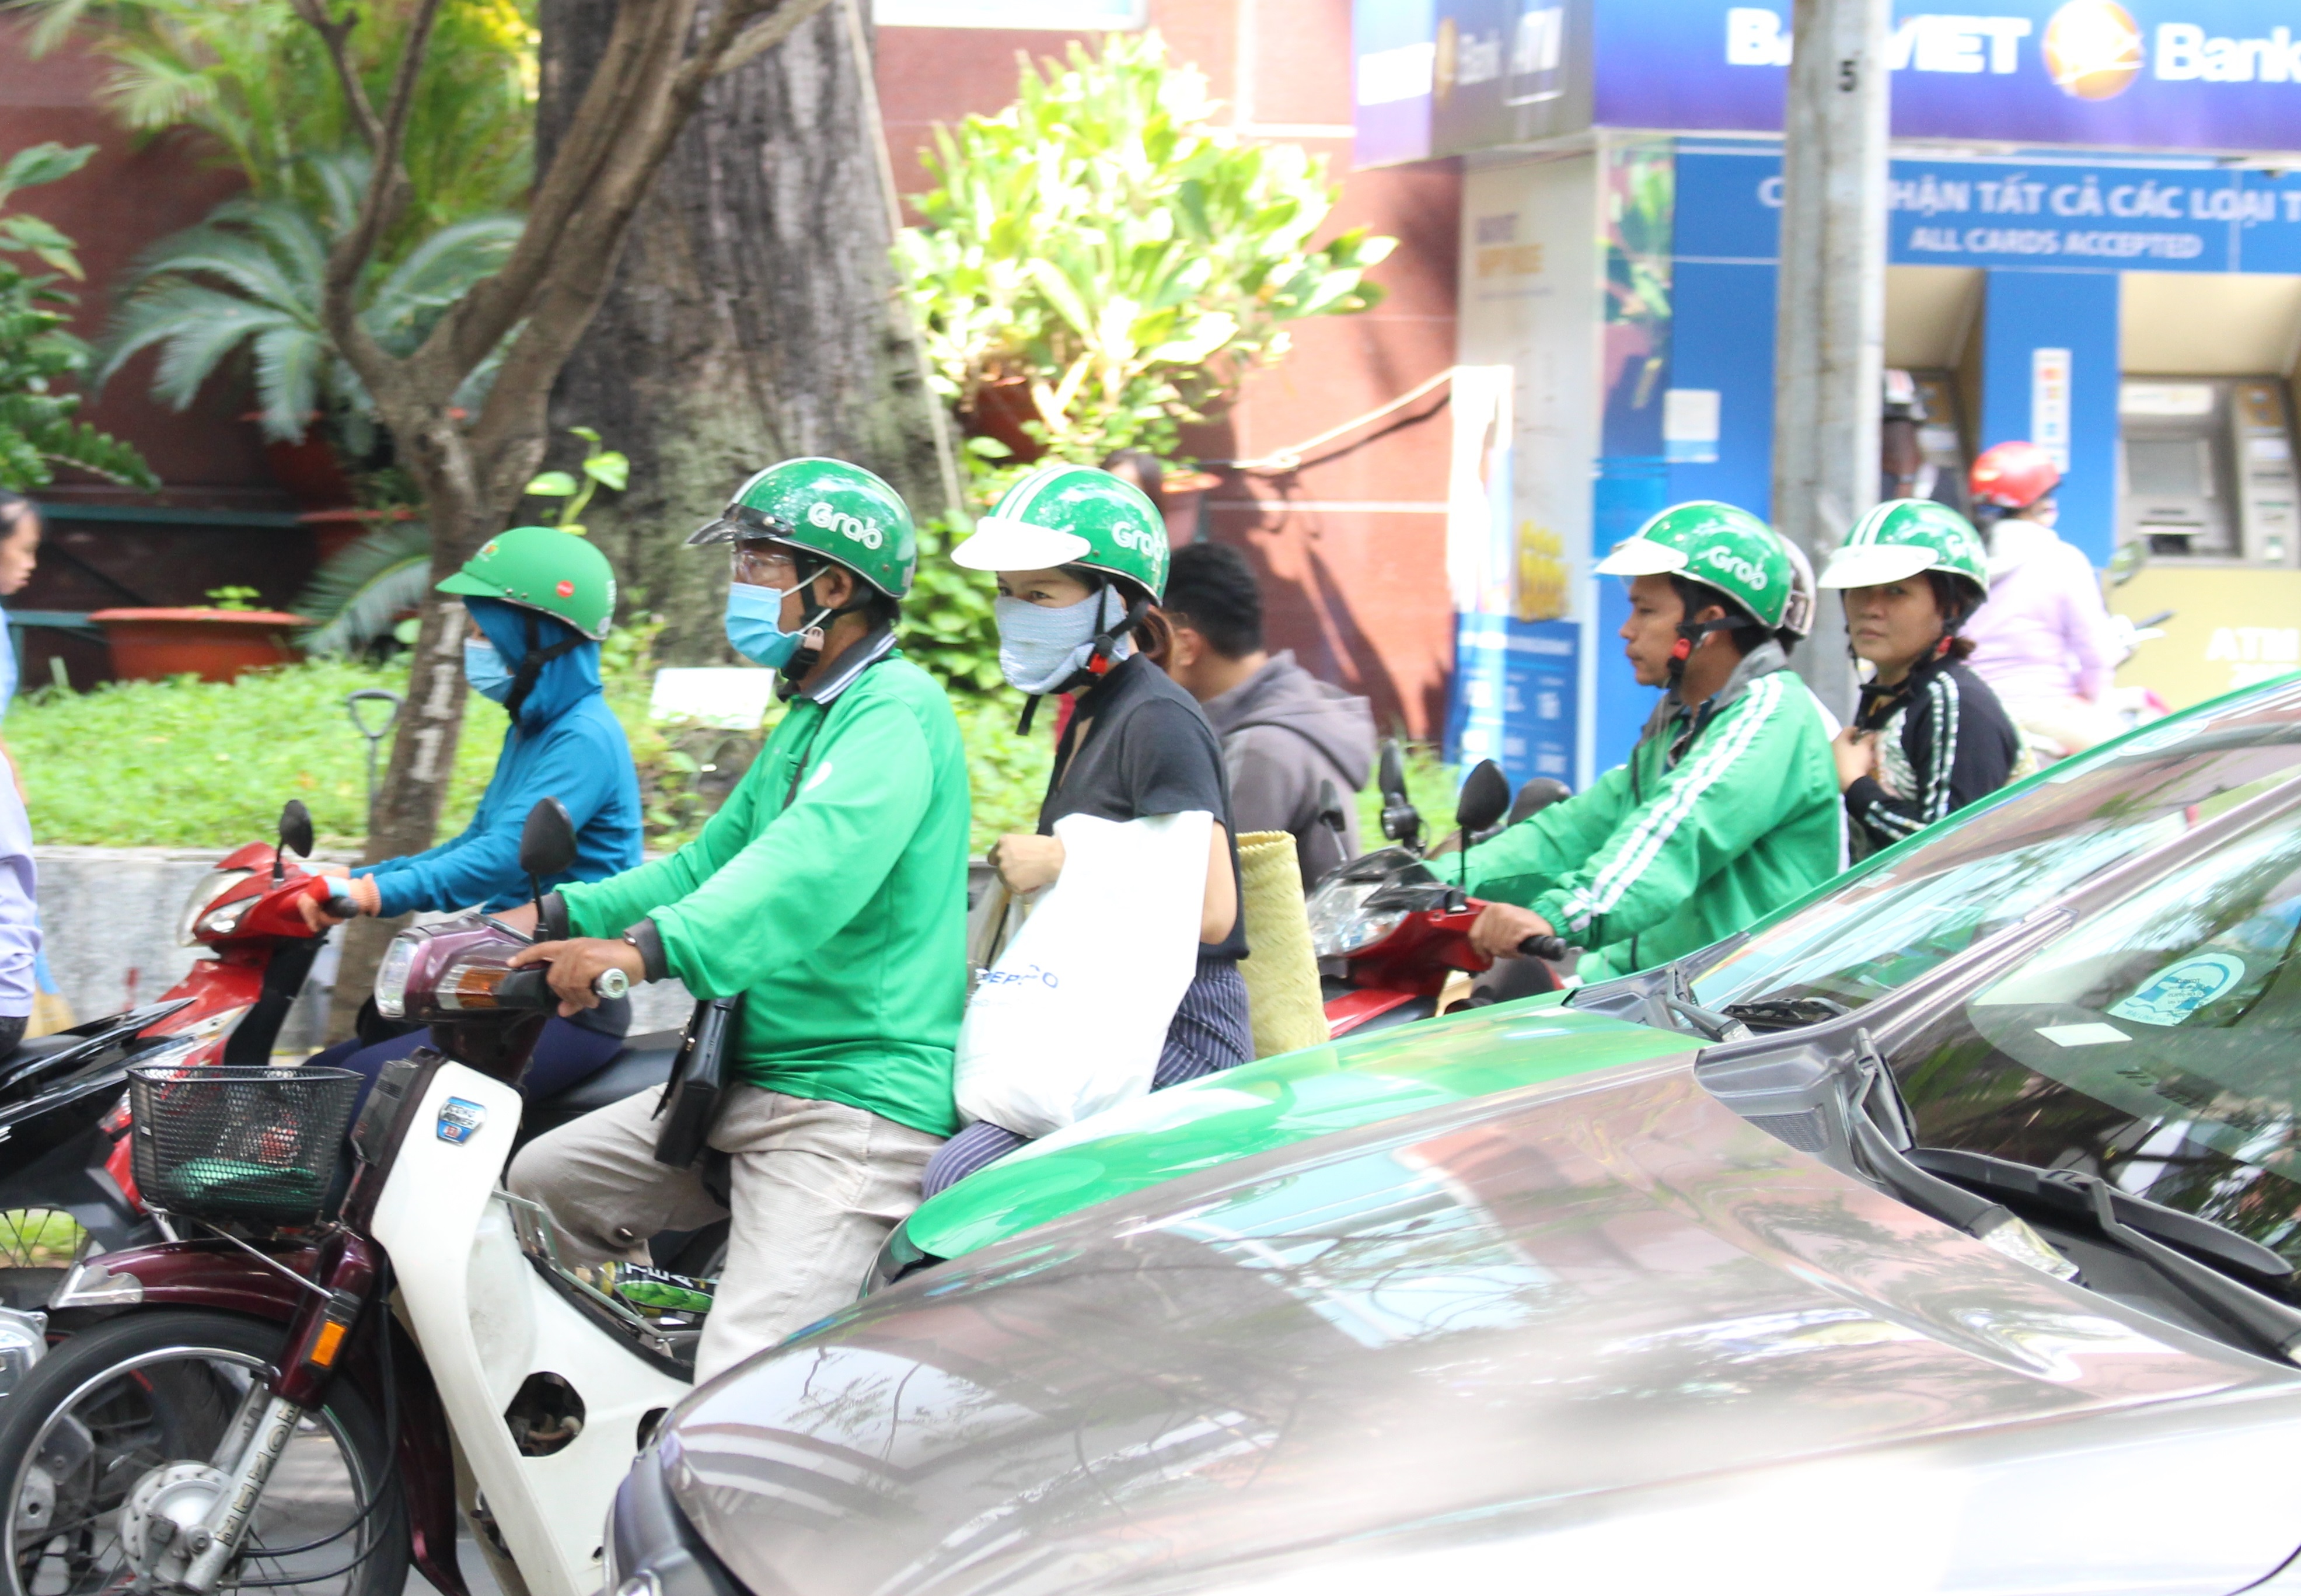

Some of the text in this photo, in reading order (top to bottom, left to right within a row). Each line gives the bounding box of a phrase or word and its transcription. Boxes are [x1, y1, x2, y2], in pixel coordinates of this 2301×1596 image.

[1838, 59, 1858, 92] 5
[1885, 175, 1972, 217] HẬN
[1976, 172, 2047, 215] TẤT
[2049, 174, 2105, 217] CẢ
[2107, 180, 2185, 219] CÁC
[2188, 188, 2275, 228] LOẠI
[1909, 228, 2205, 259] ALL CARDS ACCEPTED
[807, 501, 883, 550] Grab
[1695, 544, 1769, 591] Grab
[624, 1261, 694, 1289] TEA
